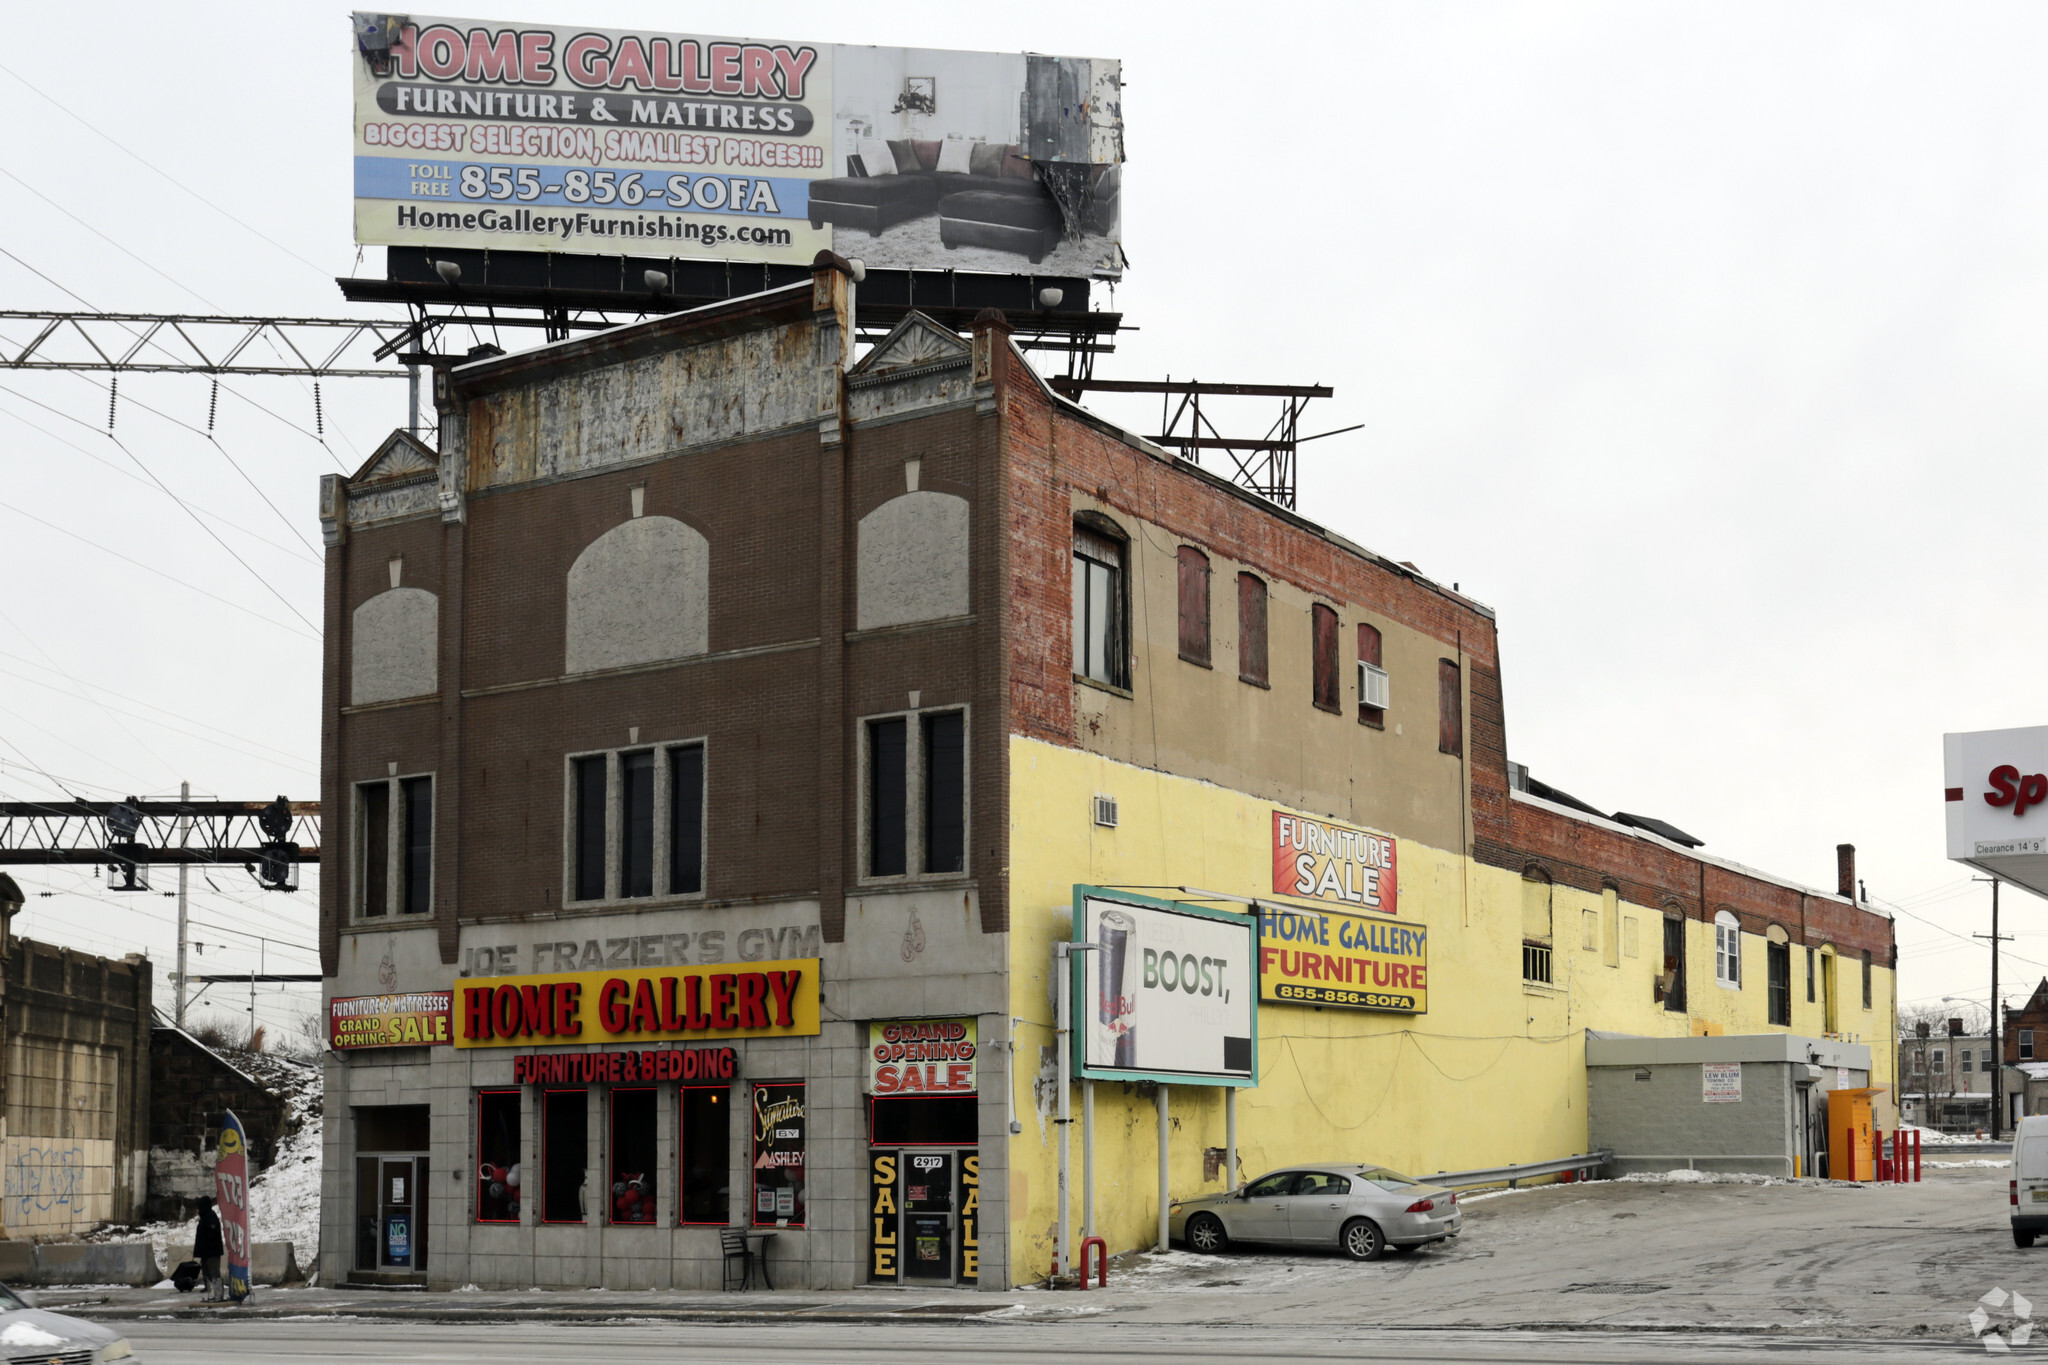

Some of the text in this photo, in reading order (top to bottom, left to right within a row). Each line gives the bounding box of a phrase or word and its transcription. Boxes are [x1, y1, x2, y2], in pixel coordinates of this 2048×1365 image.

[375, 24, 817, 100] HOME GALLERY
[396, 87, 795, 132] FURNITURE & MATTRESS
[364, 123, 823, 168] BIGGEST SELECTION, SMALLEST PRICES!!!
[408, 164, 452, 180] TOLL
[411, 181, 451, 197] FREE
[459, 165, 781, 213] 855-856-SOFA
[397, 205, 793, 246] HomeGalleryFurnishings.com
[1983, 764, 2048, 816] Sp
[1279, 816, 1391, 869] FURNITURE
[1976, 843, 2015, 854] Clearance
[1295, 853, 1380, 906] SALE
[460, 924, 820, 978] JOE FRAZIER'S GYM
[1260, 907, 1426, 957] HOME GALLERY
[1143, 947, 1230, 1004] BOOST,
[1260, 946, 1427, 990] FURNITURE
[332, 994, 449, 1017] FURNITURE & MATTRESSES
[463, 970, 801, 1039] HOME GALLERY
[1280, 986, 1412, 1008] 855-856-SOFA
[334, 1032, 386, 1047] OPENING
[339, 1017, 380, 1032] GRAND
[388, 1015, 448, 1044] SALE
[882, 1022, 966, 1043] GRAND
[514, 1047, 737, 1084] FURNITURE & BEDDING
[873, 1040, 976, 1062] OPENING
[873, 1063, 973, 1093] SALE
[755, 1088, 805, 1147] Signature
[767, 1151, 805, 1167] ASHLEY
[916, 1157, 941, 1167] 2917
[389, 1223, 407, 1236] NO
[873, 1156, 896, 1275] SALE
